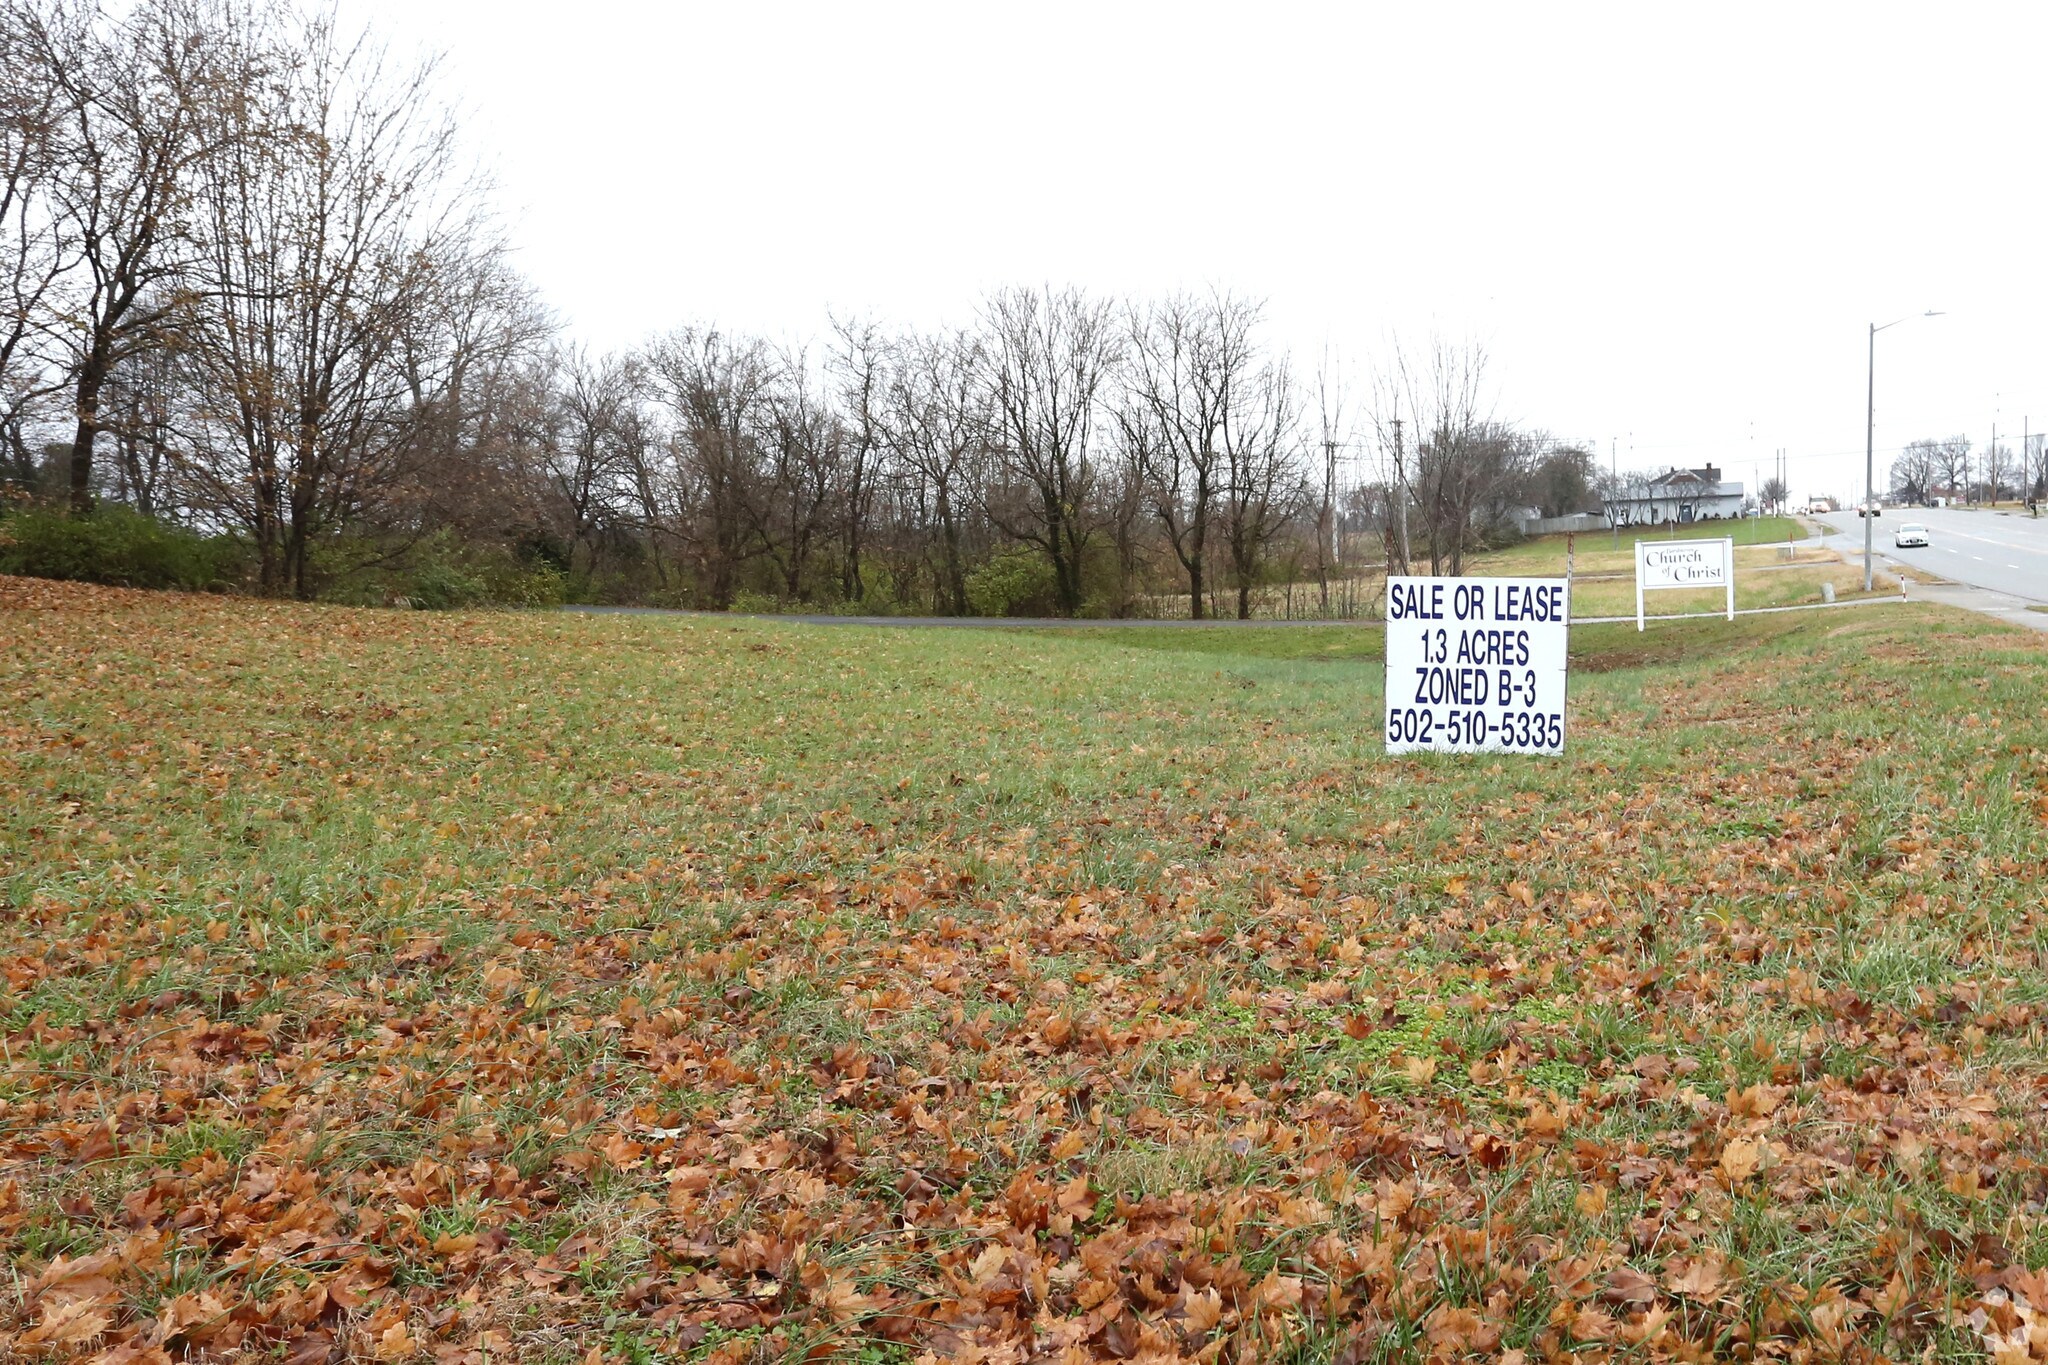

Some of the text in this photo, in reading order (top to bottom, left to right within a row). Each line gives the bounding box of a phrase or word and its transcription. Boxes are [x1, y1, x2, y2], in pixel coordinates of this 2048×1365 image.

[1646, 550, 1702, 567] Church
[1661, 566, 1721, 582] of Christ
[1391, 583, 1563, 622] SALE OR LEASE
[1421, 628, 1530, 666] 1.3 ACRES
[1415, 667, 1536, 708] ZONED B-3
[1388, 708, 1562, 748] 502-510-5335
